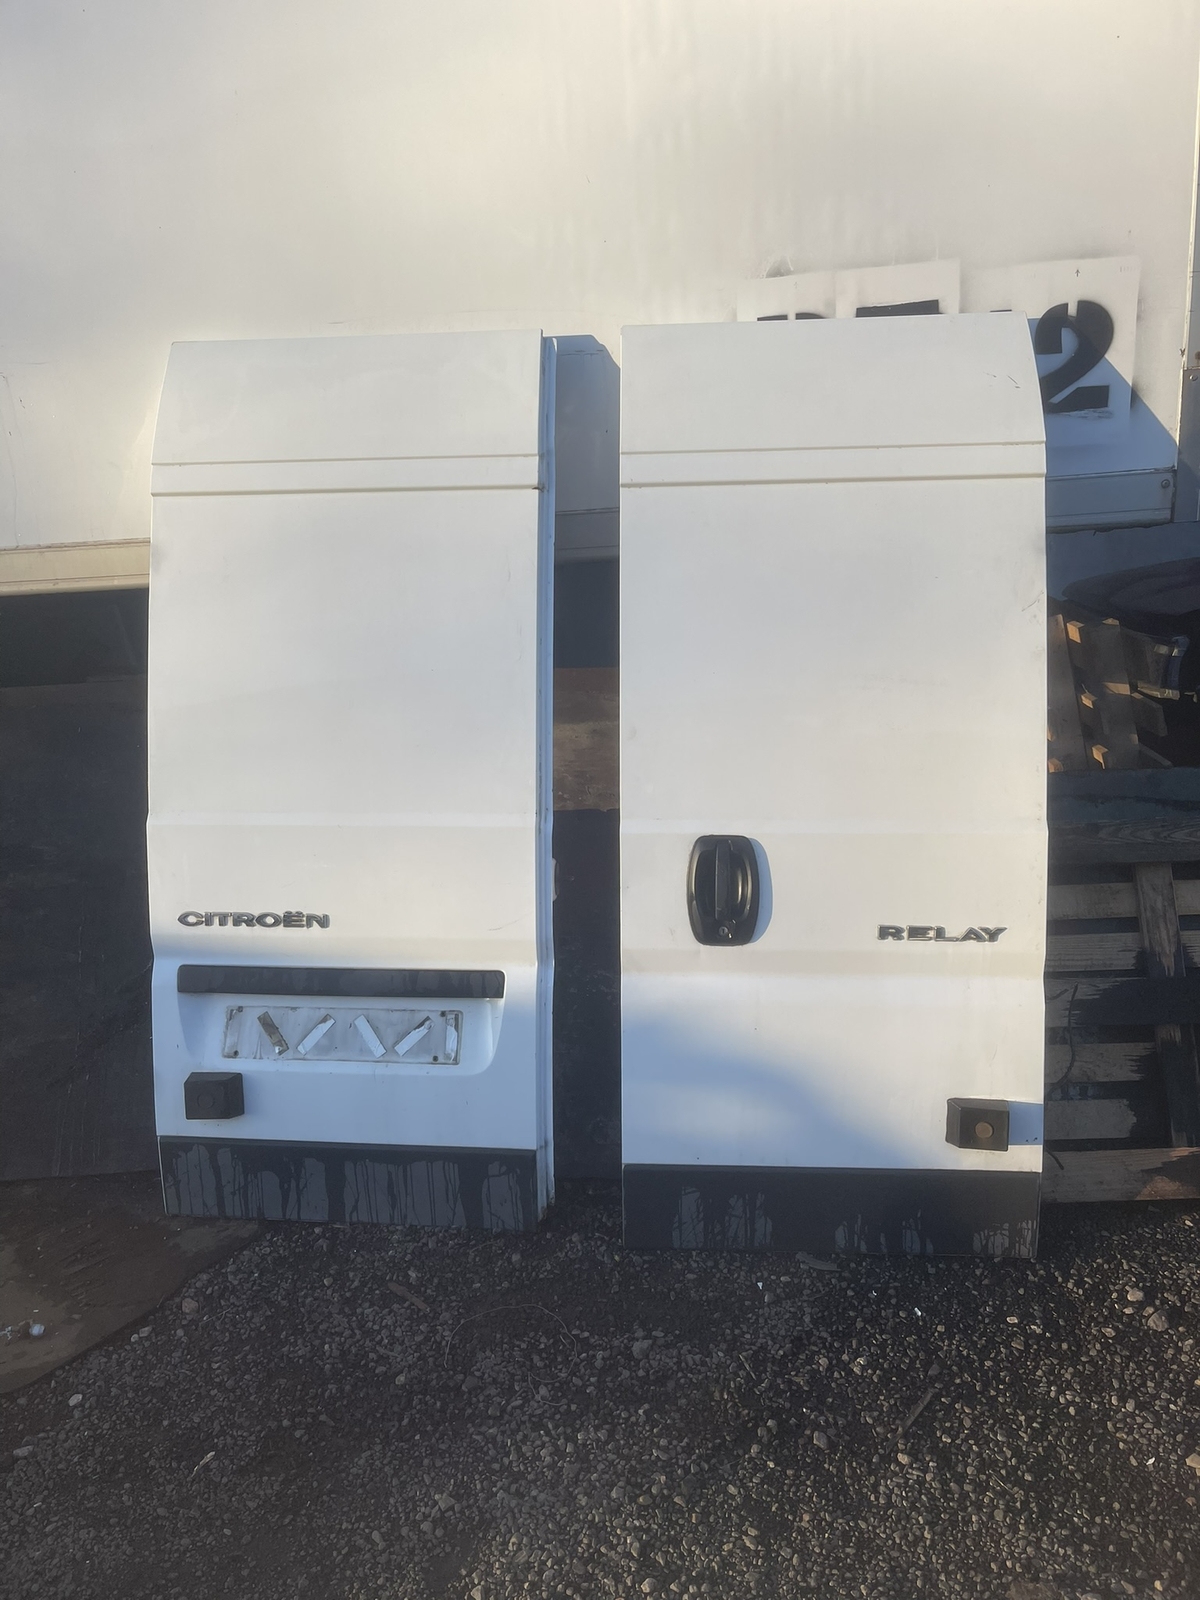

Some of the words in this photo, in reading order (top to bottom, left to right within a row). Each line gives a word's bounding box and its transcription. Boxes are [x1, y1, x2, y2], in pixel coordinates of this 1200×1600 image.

[990, 299, 1114, 413] 2
[178, 911, 330, 929] CITROËN
[878, 925, 1006, 942] RELAY
